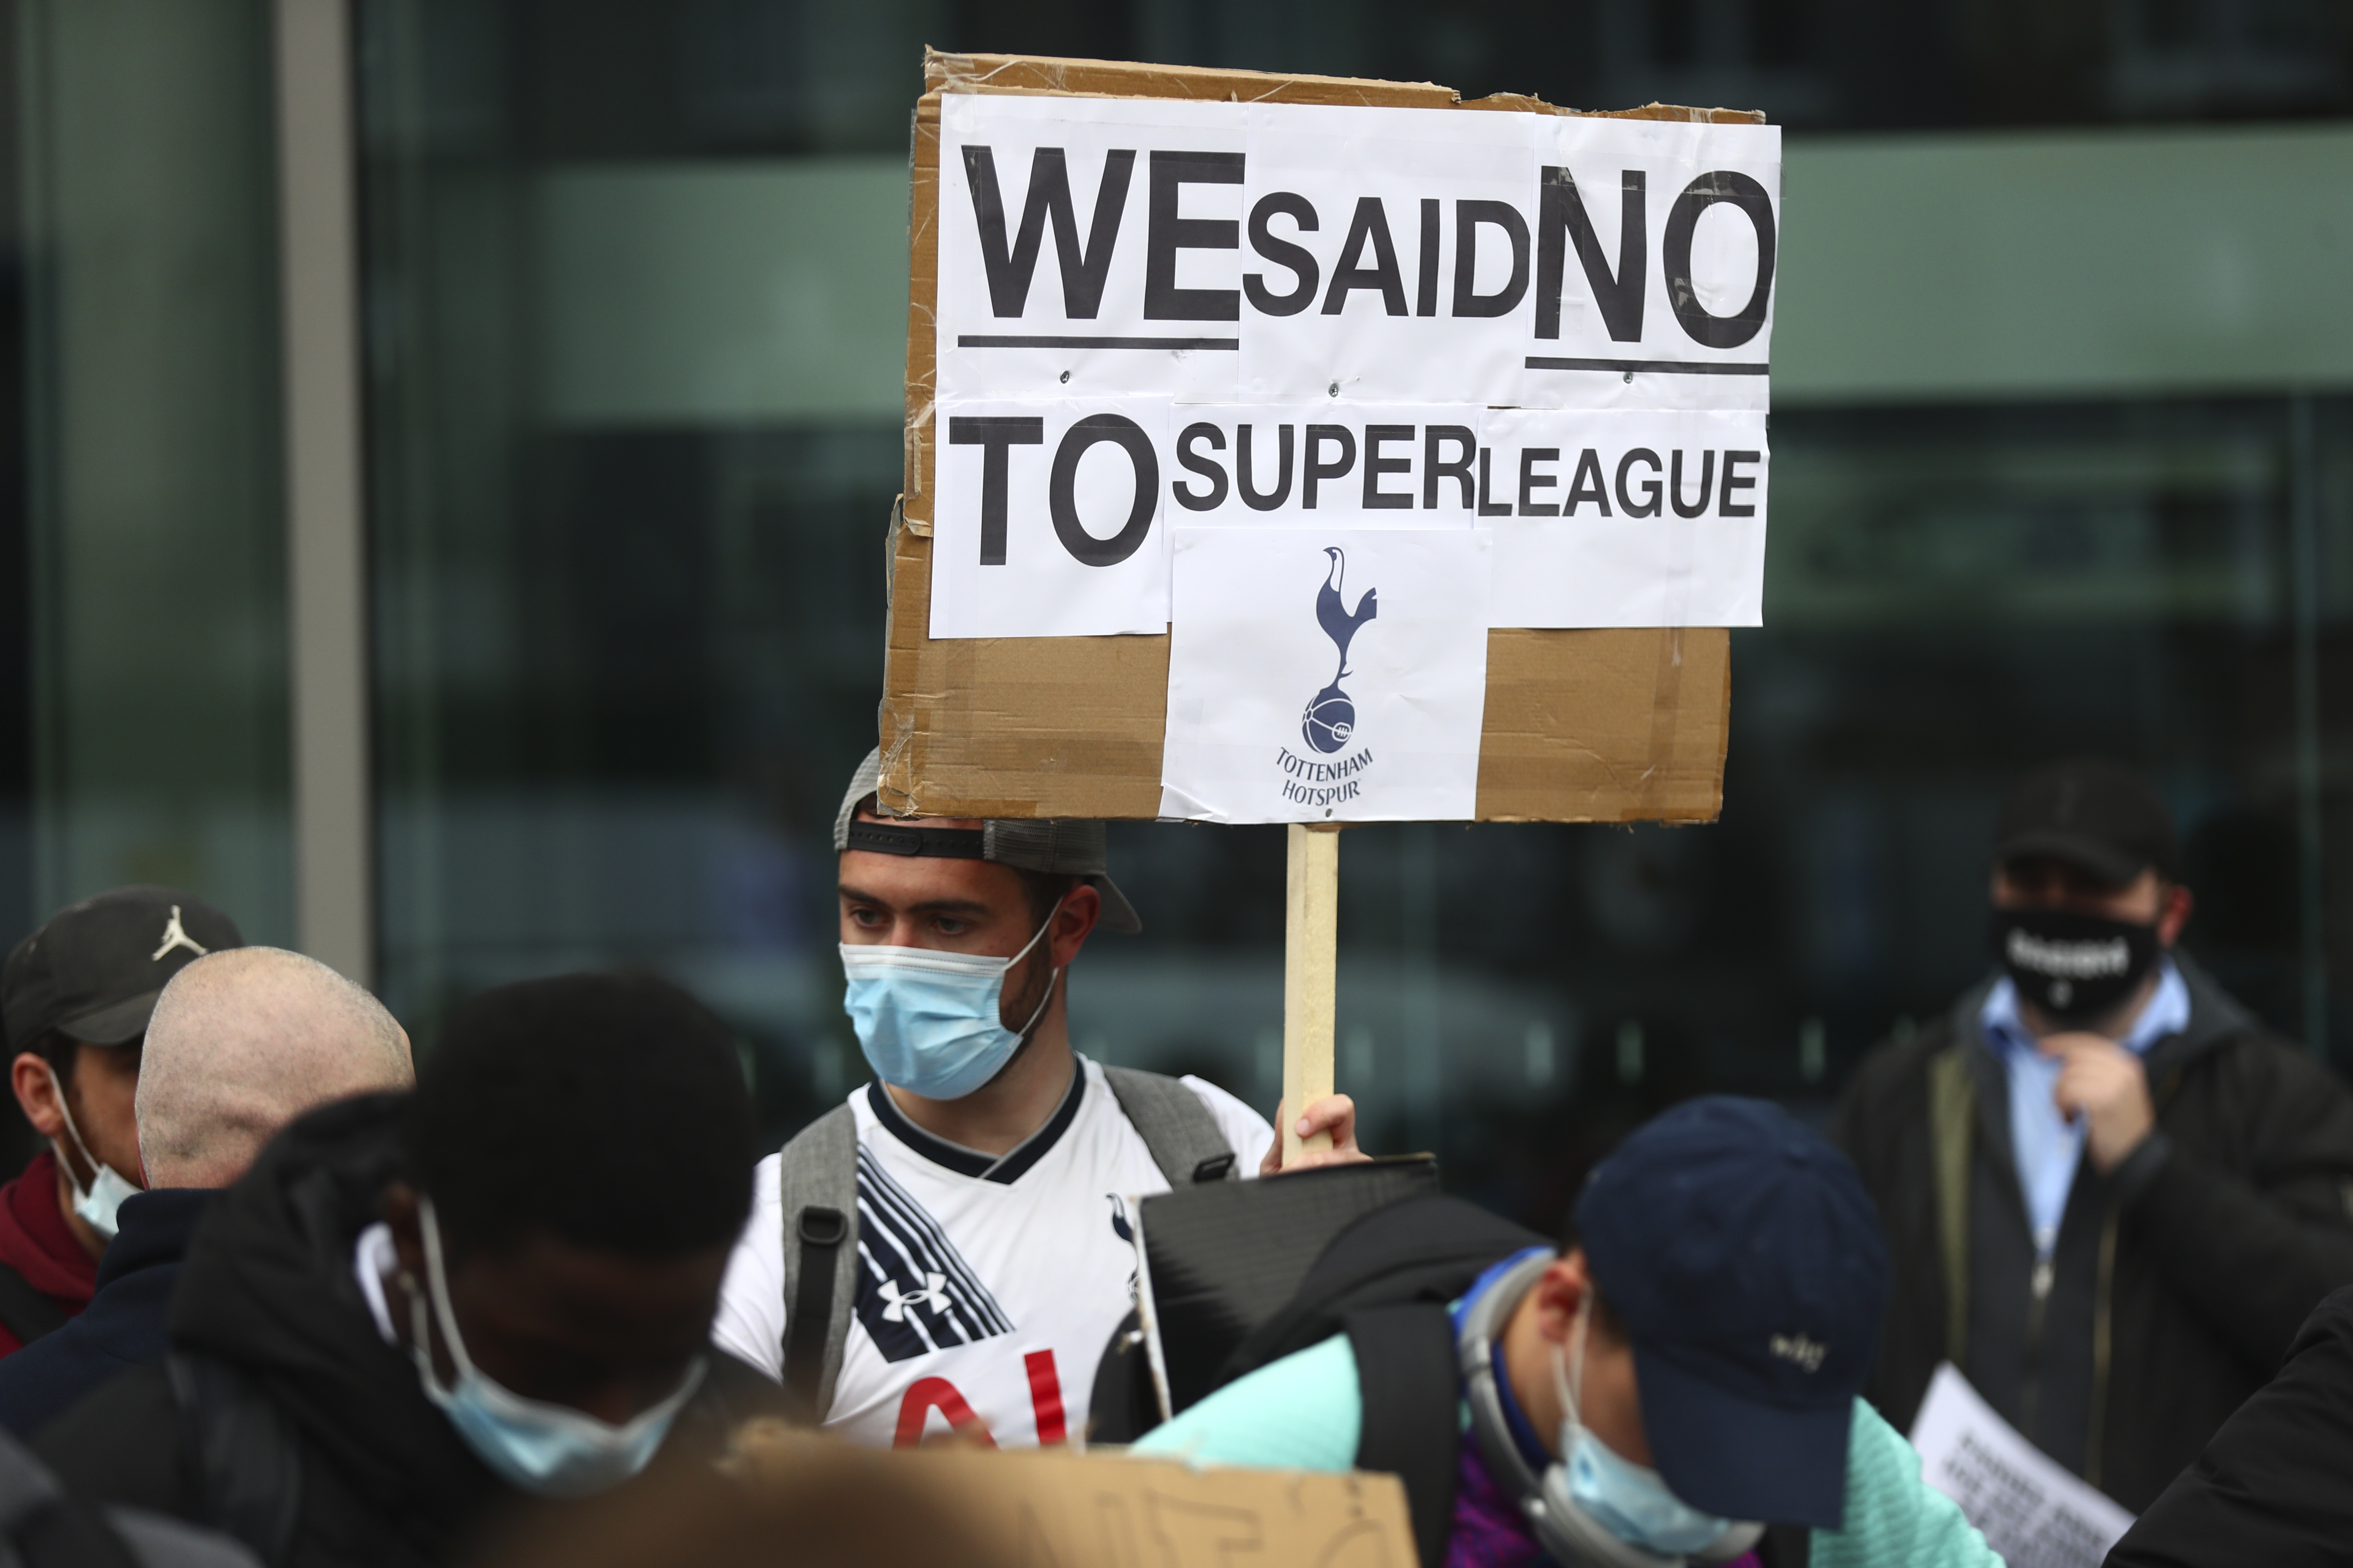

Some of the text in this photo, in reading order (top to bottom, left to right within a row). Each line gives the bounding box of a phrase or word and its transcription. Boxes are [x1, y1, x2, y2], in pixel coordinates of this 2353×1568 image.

[961, 144, 1777, 350] WE SAID NO
[948, 413, 1761, 568] TO SUPER LEAGUE
[1276, 746, 1373, 781] TOTTENHAM
[1282, 779, 1360, 806] HOTSPUR
